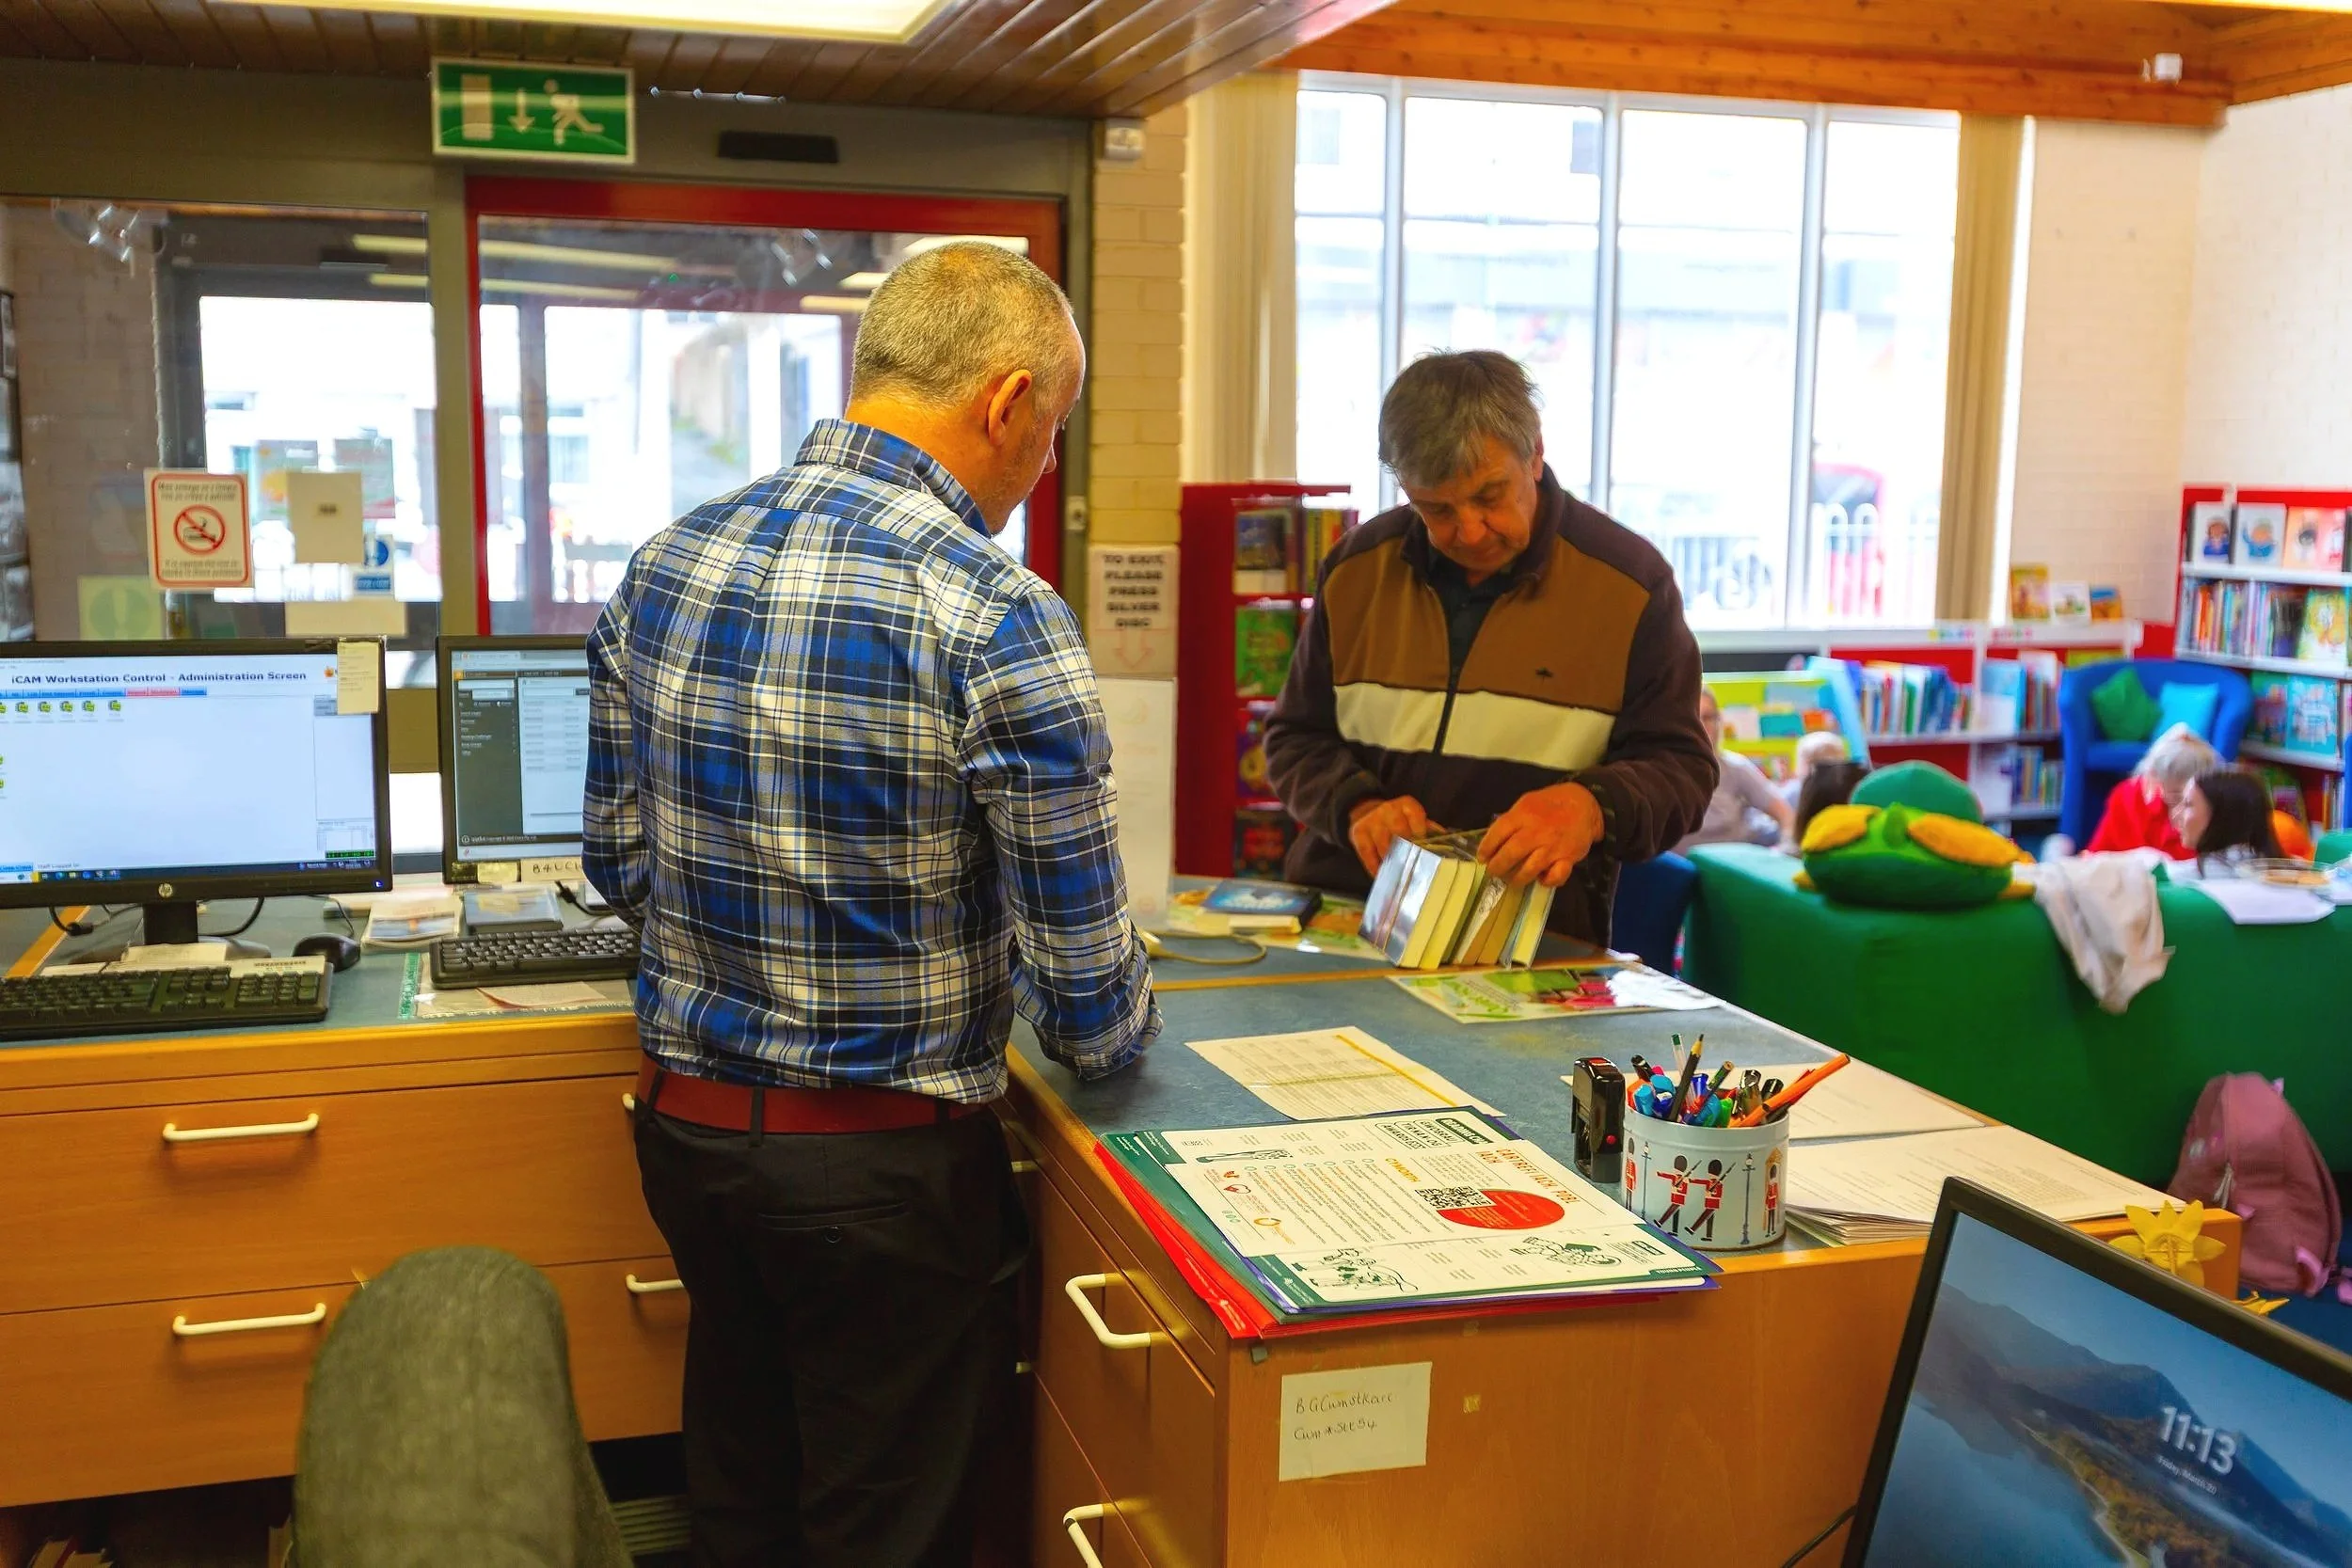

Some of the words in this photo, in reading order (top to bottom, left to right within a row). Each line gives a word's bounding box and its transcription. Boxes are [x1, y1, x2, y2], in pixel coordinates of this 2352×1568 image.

[11, 674, 41, 685] iCAM
[45, 673, 119, 685] Workstation
[122, 673, 167, 683] Control
[178, 671, 264, 682] Administration
[267, 671, 308, 681] Screen
[1475, 1150, 1503, 1164] IACH
[1496, 1148, 1539, 1174] CARTREFI
[2159, 1405, 2236, 1475] 11:13
